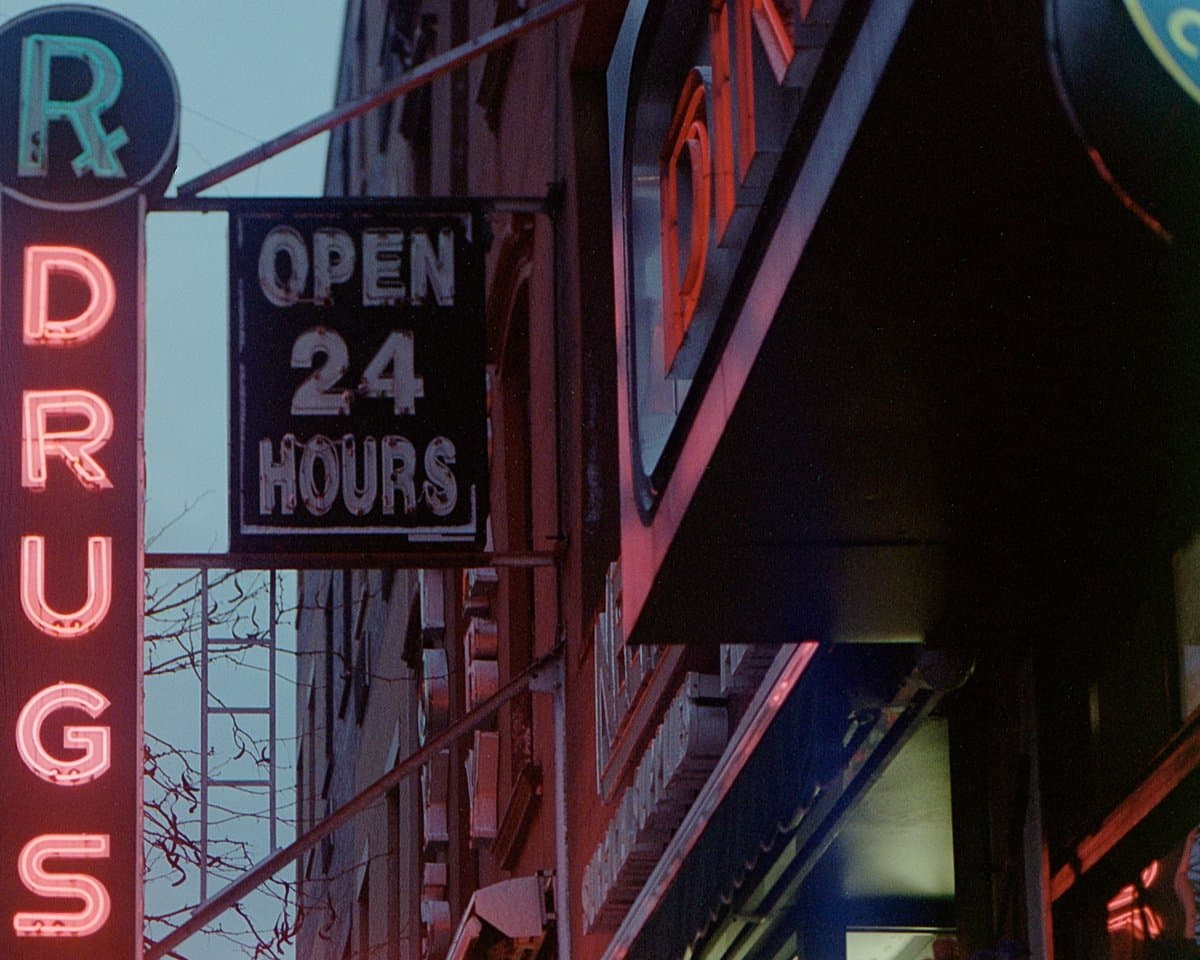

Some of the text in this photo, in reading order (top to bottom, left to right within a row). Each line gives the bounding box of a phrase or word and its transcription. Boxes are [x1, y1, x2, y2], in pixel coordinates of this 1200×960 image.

[257, 225, 456, 307] OPEN
[290, 326, 425, 416] 24
[258, 434, 458, 517] HOURS
[13, 245, 119, 938] DRUGS
